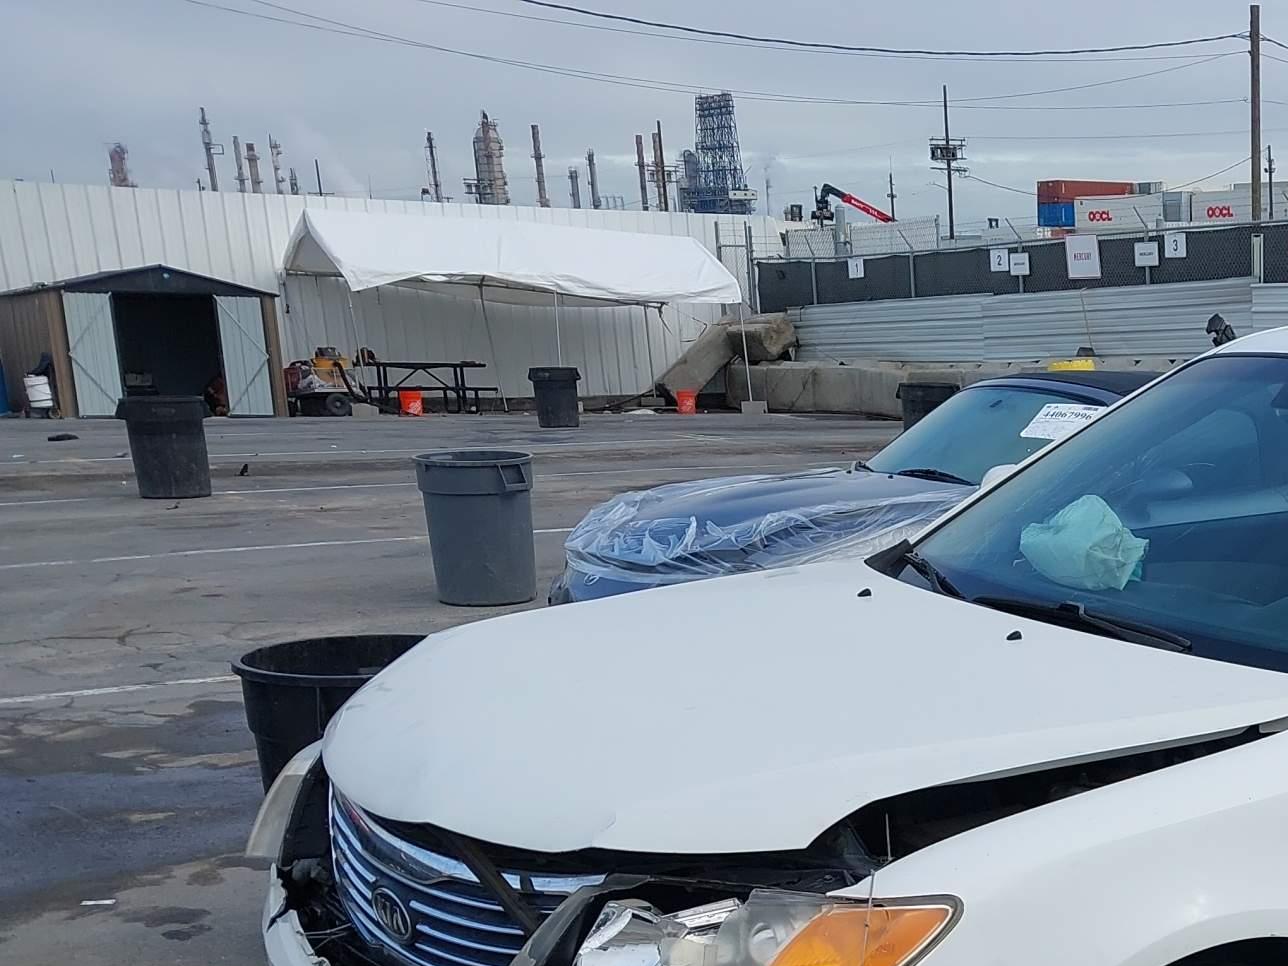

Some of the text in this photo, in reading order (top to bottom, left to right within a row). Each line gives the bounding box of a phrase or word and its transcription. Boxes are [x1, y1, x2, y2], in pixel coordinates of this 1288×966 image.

[1088, 210, 1112, 222] OOCL
[1206, 206, 1233, 218] OOCL
[1172, 239, 1178, 251] 3
[996, 255, 1002, 266] 2
